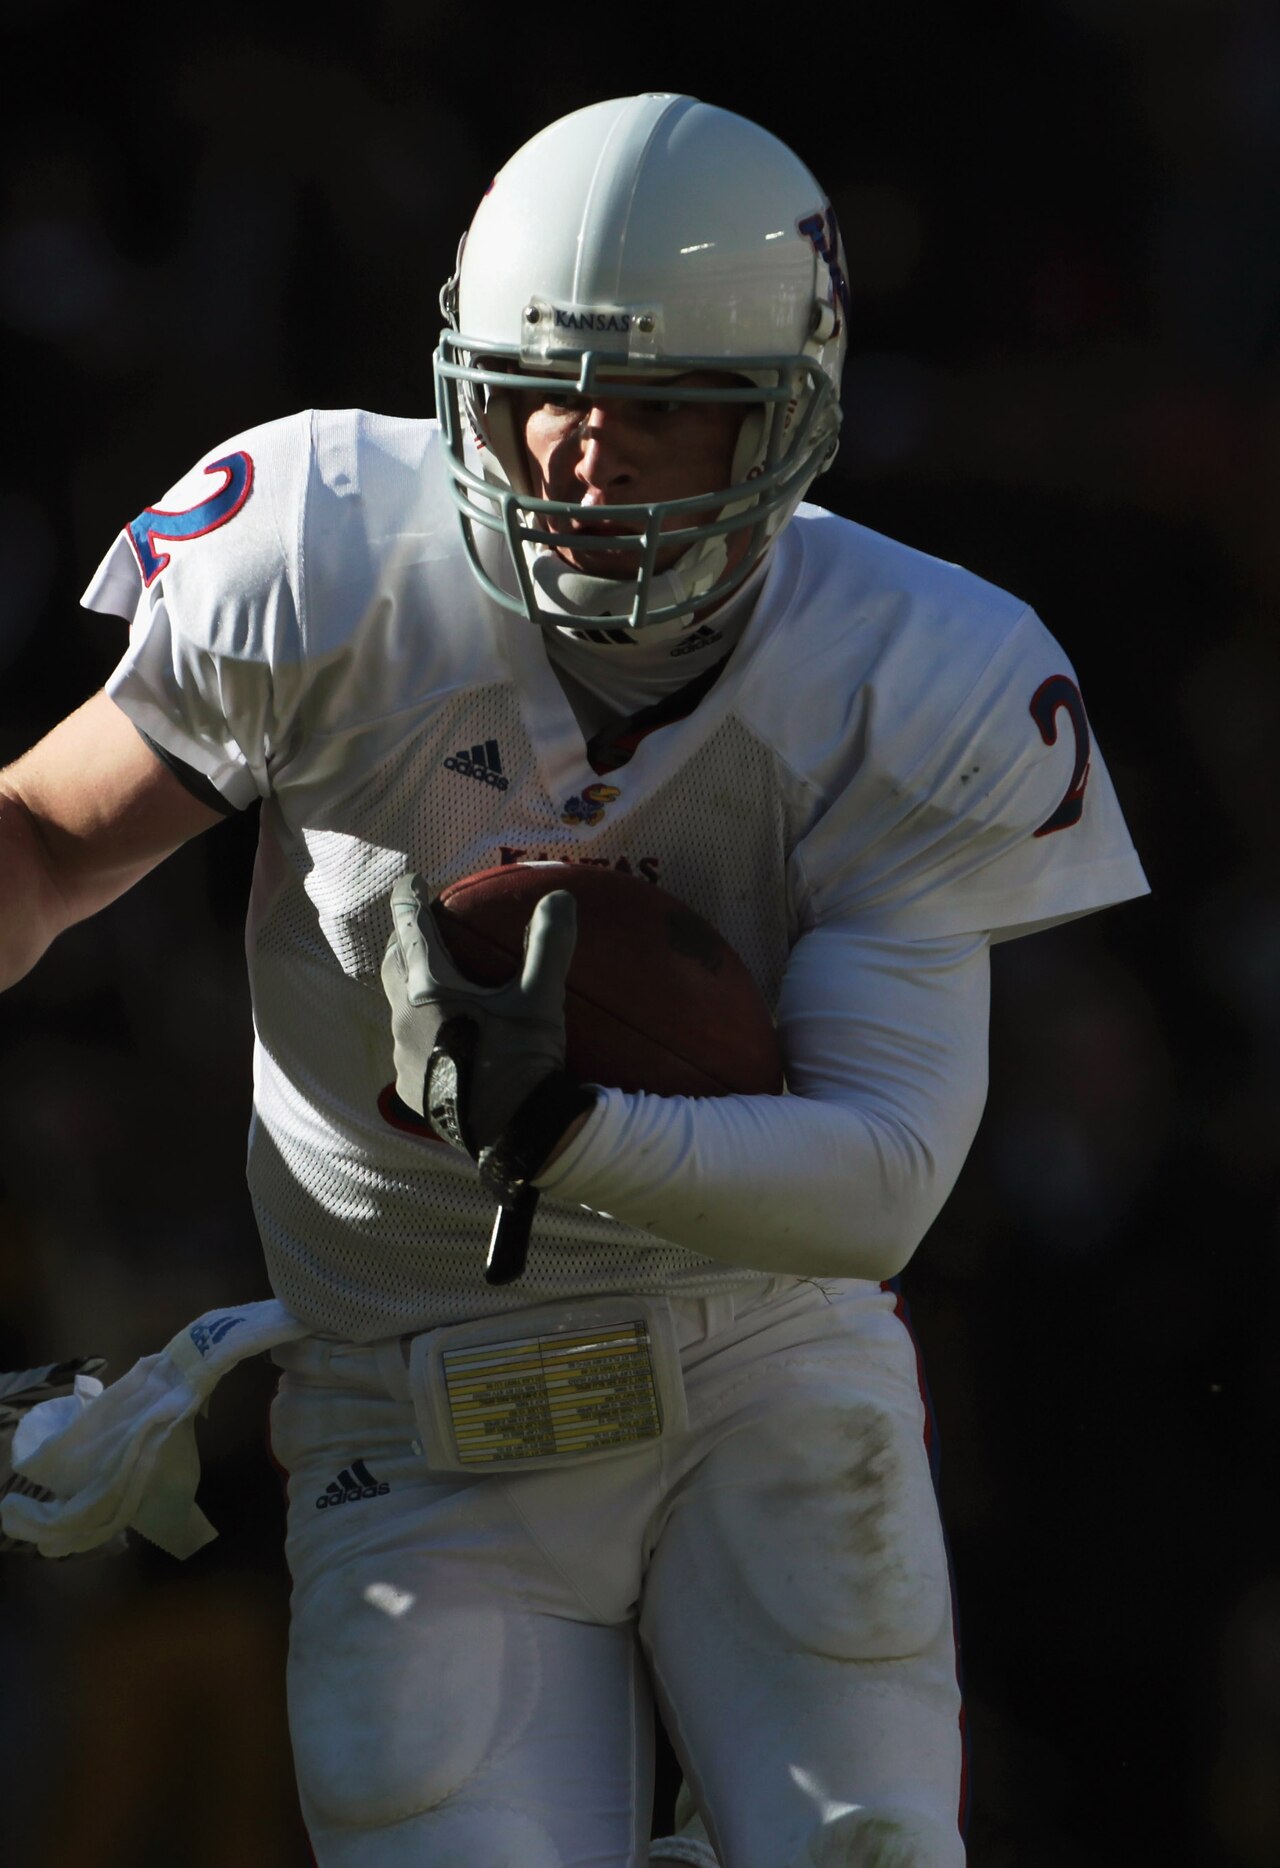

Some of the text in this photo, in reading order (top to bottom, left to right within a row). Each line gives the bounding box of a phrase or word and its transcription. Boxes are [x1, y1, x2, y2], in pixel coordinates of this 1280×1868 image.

[555, 309, 630, 332] KANSAS
[123, 450, 255, 588] 2
[1029, 674, 1091, 838] 2
[443, 757, 509, 791] adidas
[316, 1482, 390, 1510] adidas
